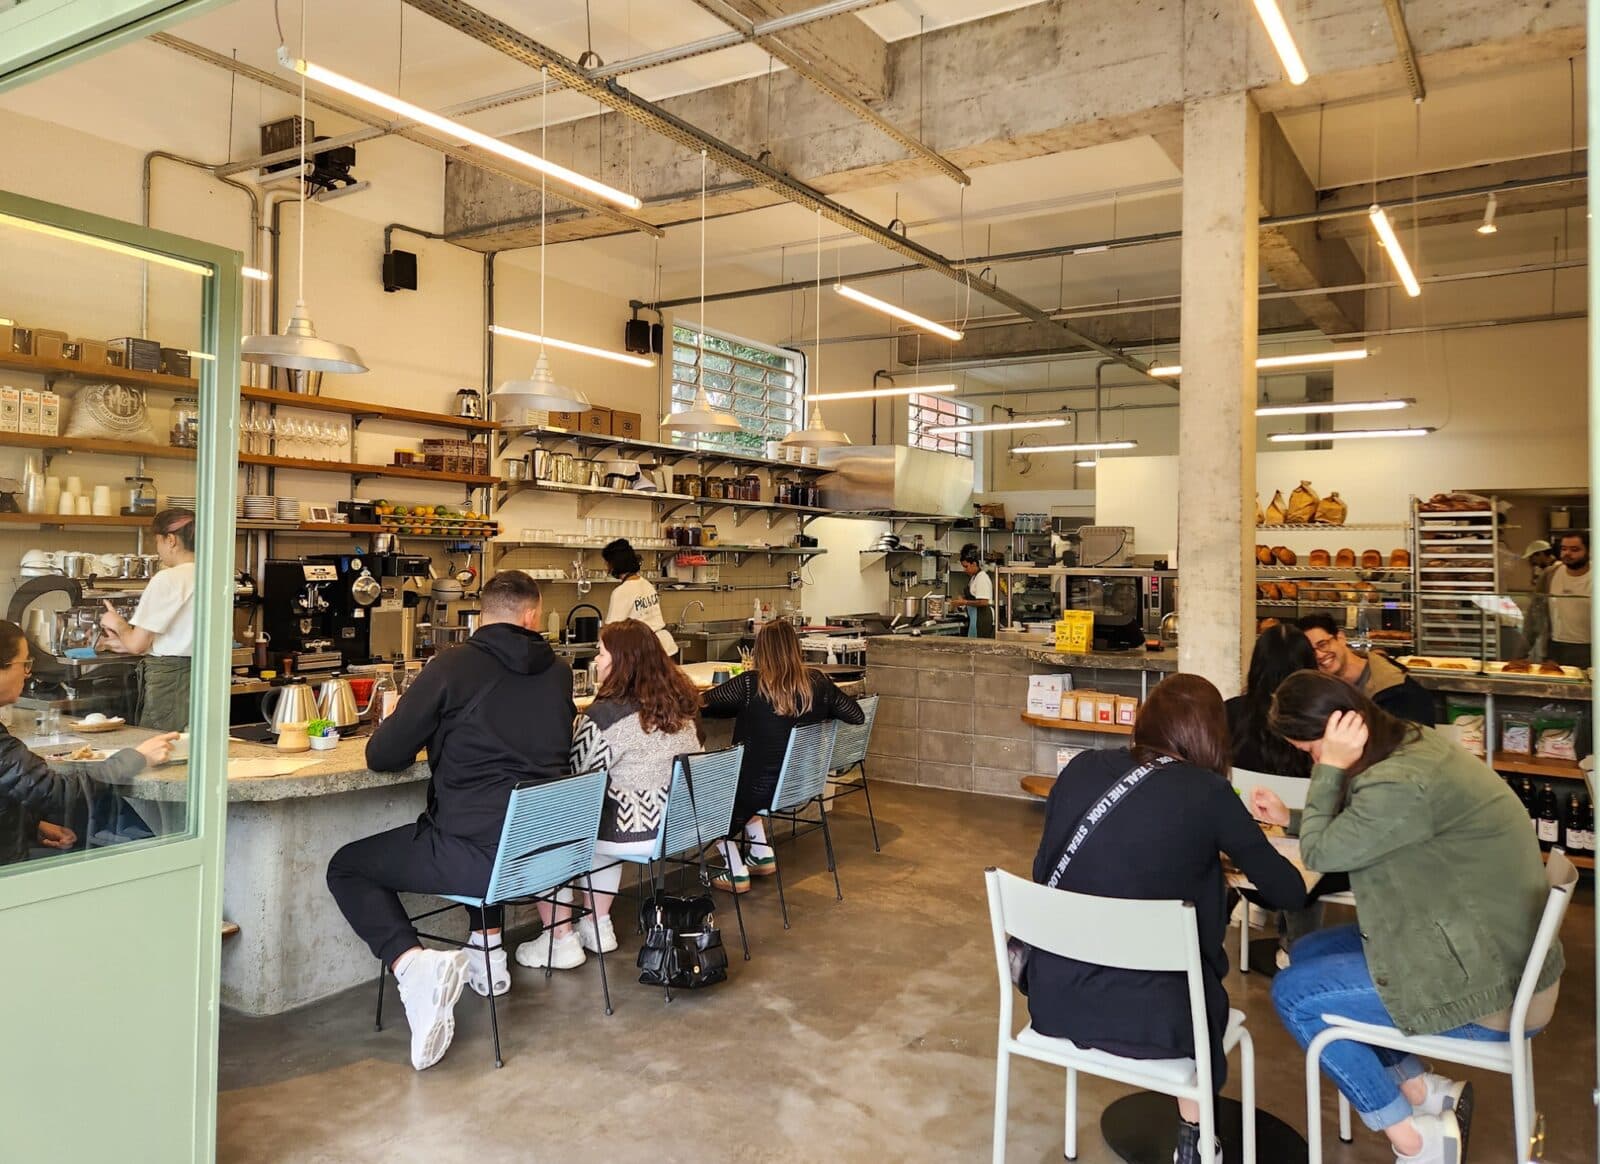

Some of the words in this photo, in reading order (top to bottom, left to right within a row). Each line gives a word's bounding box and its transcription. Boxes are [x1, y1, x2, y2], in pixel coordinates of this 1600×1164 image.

[1107, 784, 1129, 803] THE
[1086, 798, 1112, 825] LOOK
[1066, 825, 1089, 855] STEAL
[1057, 853, 1072, 874] THE
[1048, 869, 1062, 889] LOO
